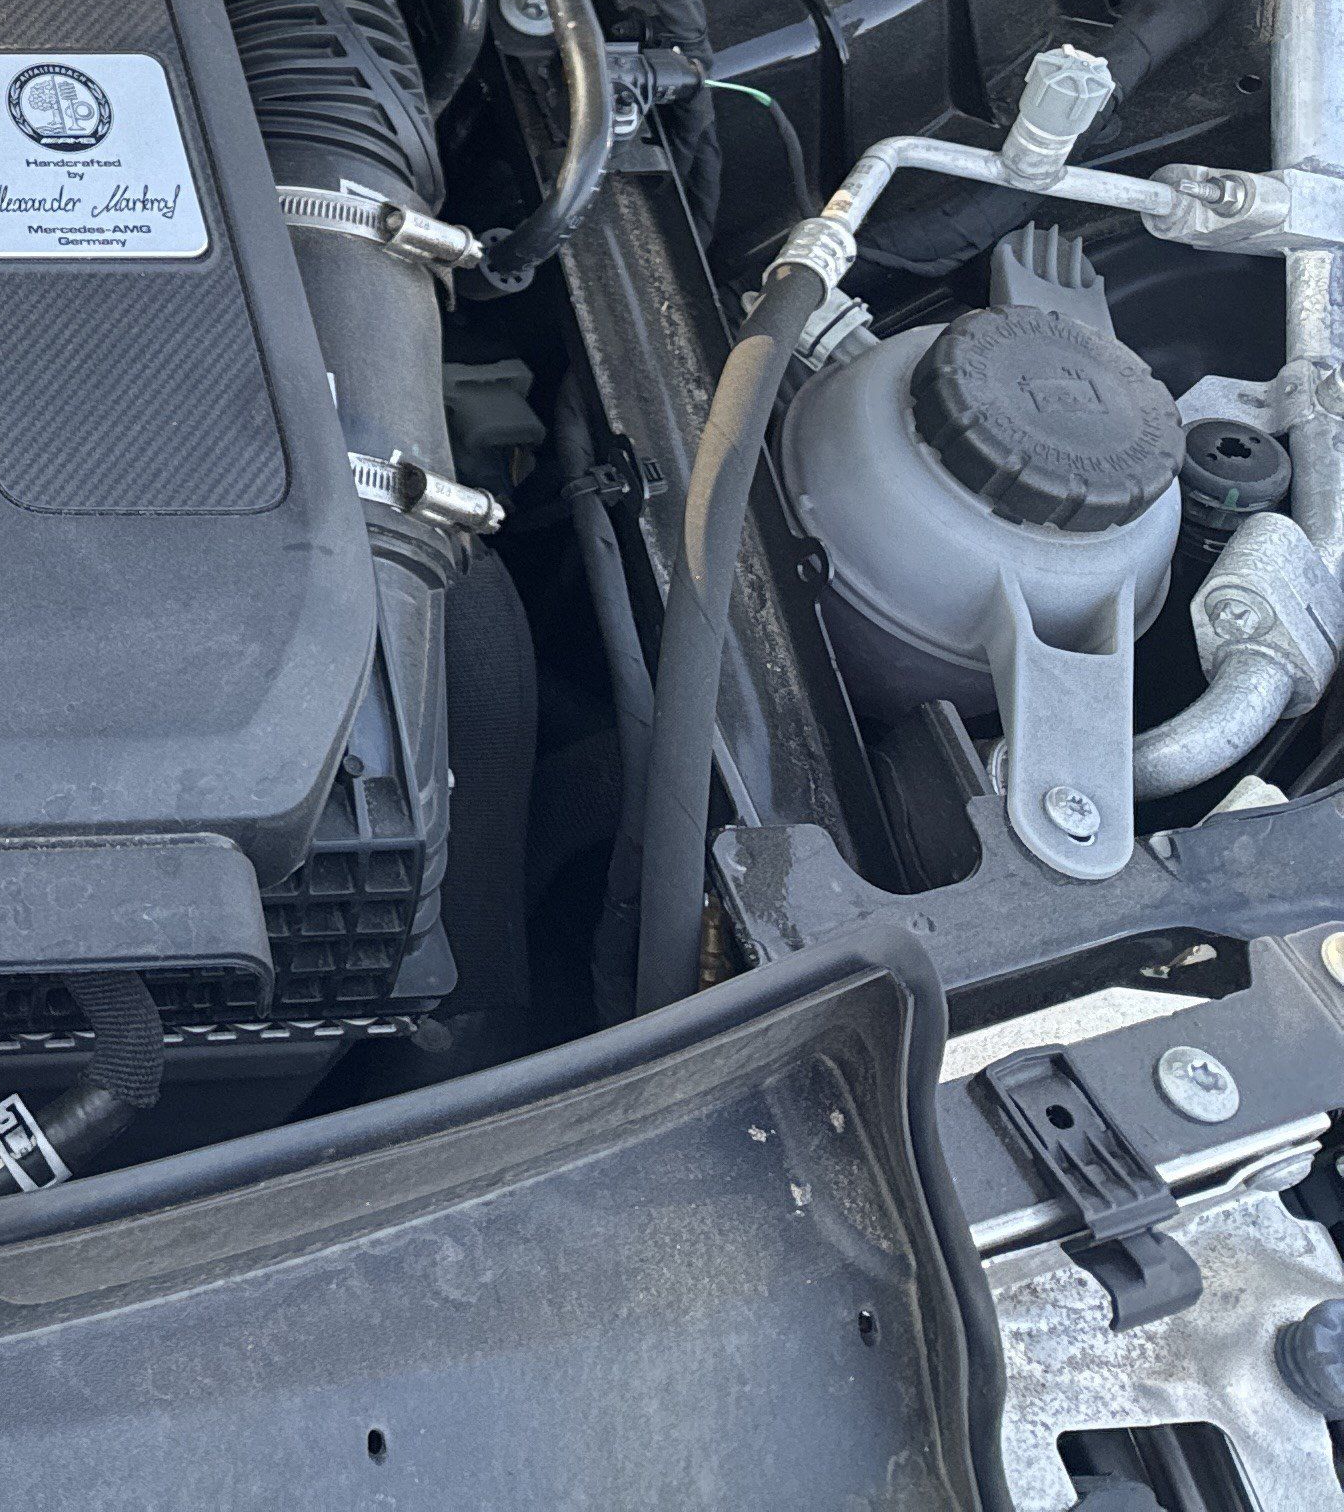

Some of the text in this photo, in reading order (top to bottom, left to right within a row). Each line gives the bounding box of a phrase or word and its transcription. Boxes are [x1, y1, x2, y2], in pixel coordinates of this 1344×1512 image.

[25, 158, 122, 168] Handcrafted
[66, 170, 85, 181] by
[27, 224, 152, 235] Mercedes-AMG
[57, 236, 128, 248] Germany
